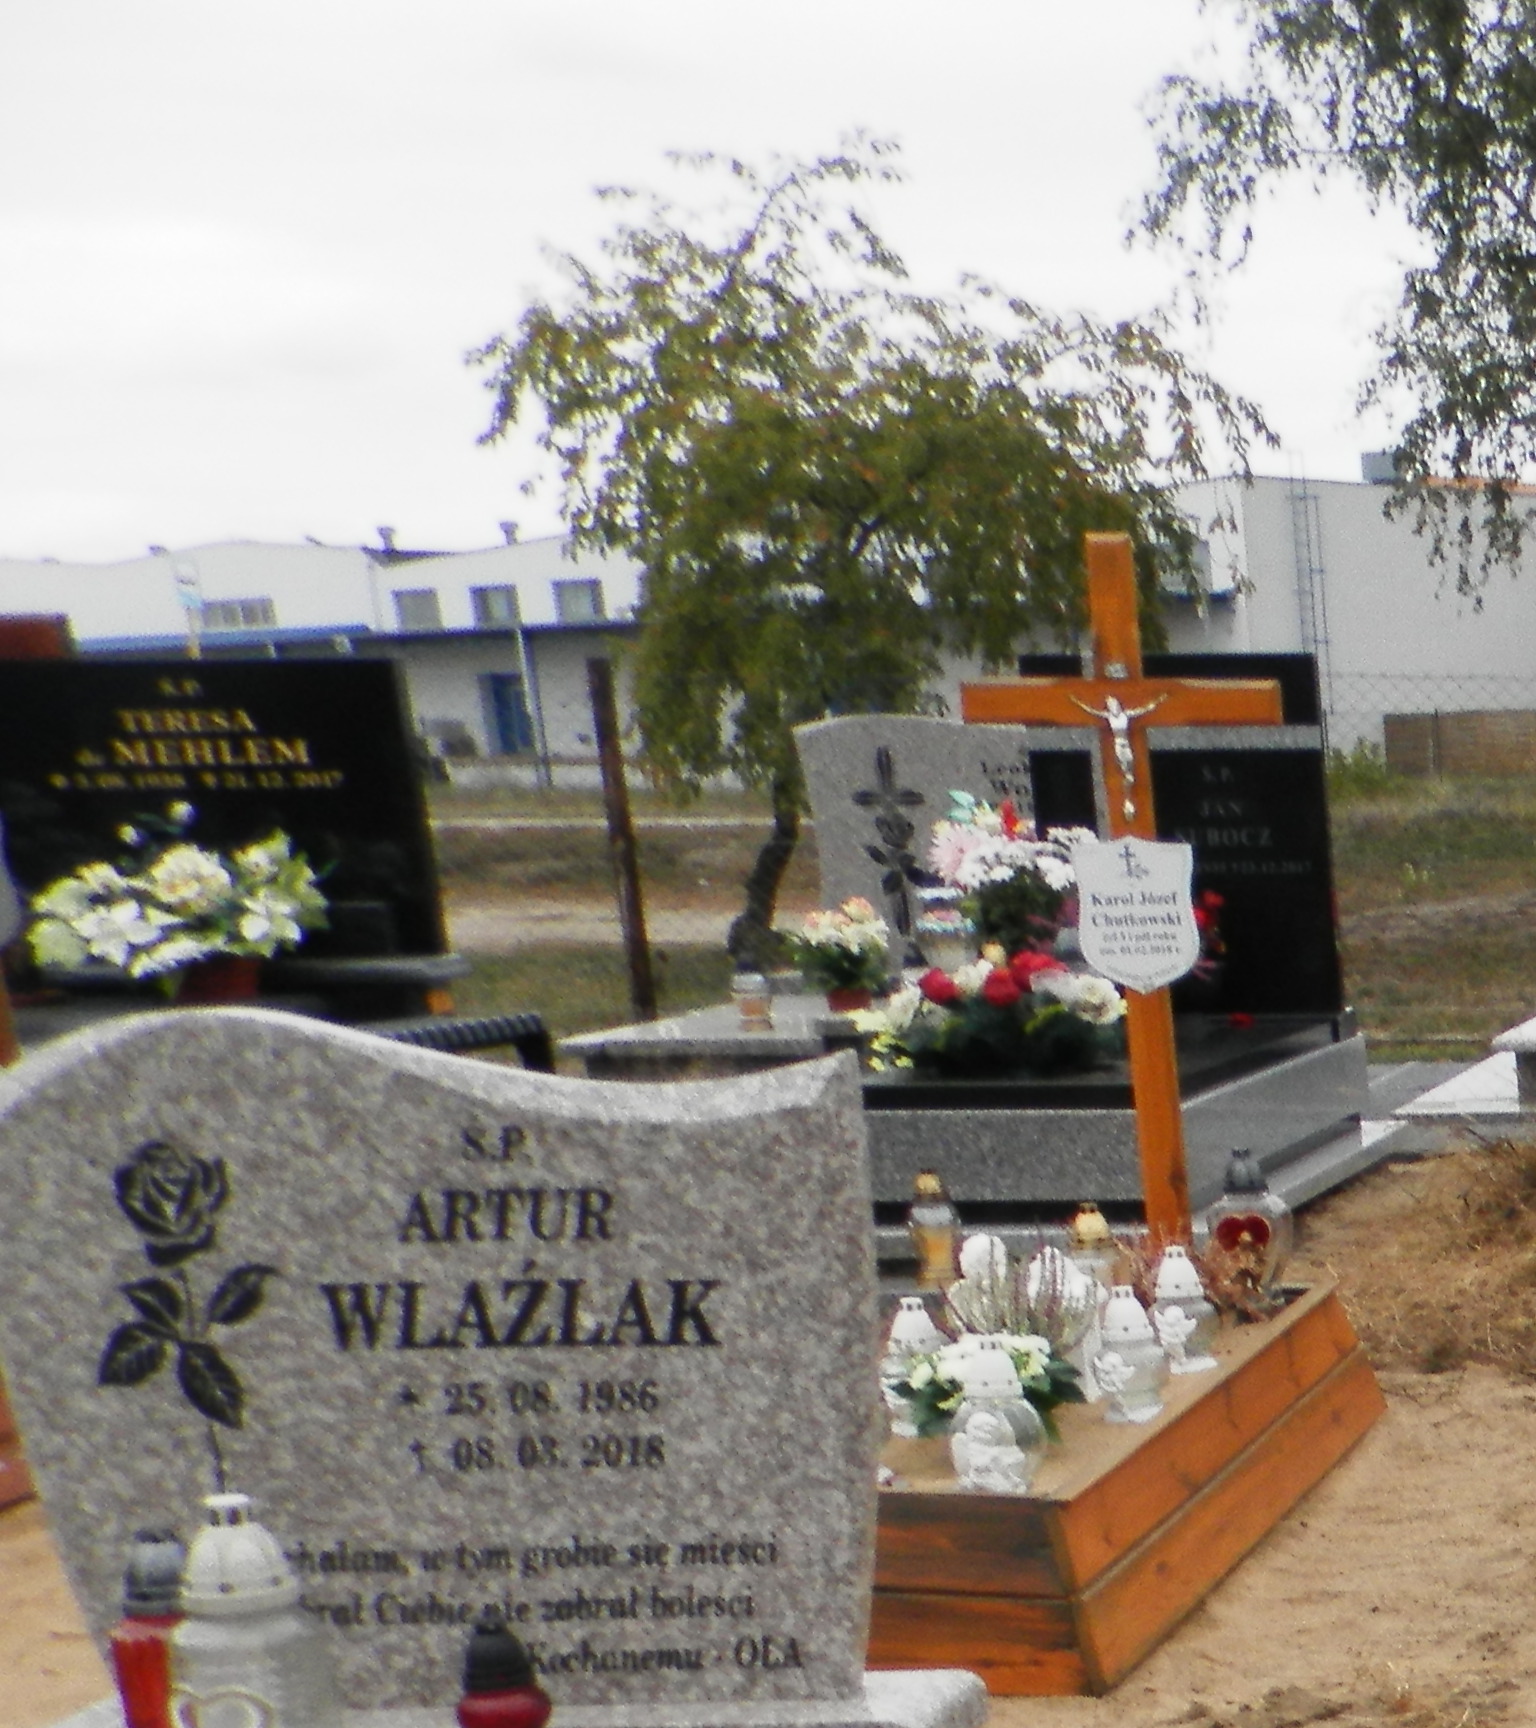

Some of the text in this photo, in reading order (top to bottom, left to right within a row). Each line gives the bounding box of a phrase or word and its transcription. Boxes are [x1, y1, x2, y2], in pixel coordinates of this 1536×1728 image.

[116, 707, 255, 733] TERESA
[1091, 892, 1134, 906] Karol
[398, 1186, 614, 1243] ARTUR
[581, 1433, 667, 1469] 2018
[456, 1543, 512, 1578] tym
[522, 1536, 617, 1577] grobie
[376, 1592, 470, 1626] Ciebie
